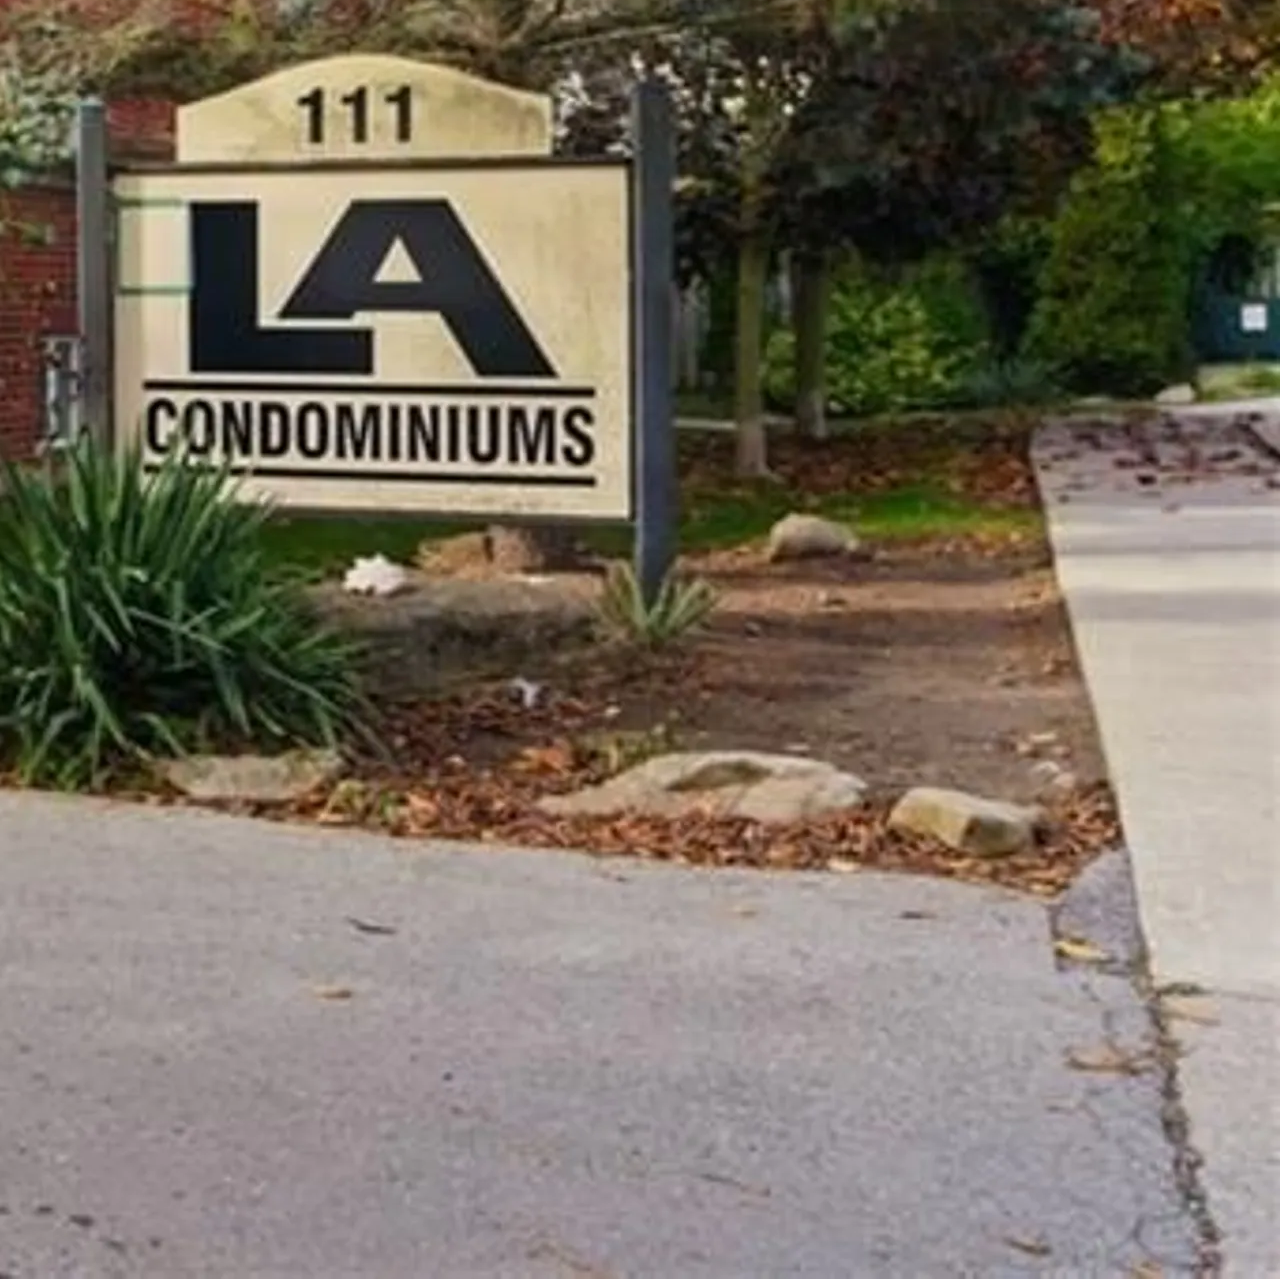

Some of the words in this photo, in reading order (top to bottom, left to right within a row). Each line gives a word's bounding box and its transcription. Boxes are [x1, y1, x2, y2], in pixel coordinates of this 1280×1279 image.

[297, 86, 413, 143] 111
[189, 199, 558, 377] LA
[145, 398, 595, 466] CONDOMINIUMS
